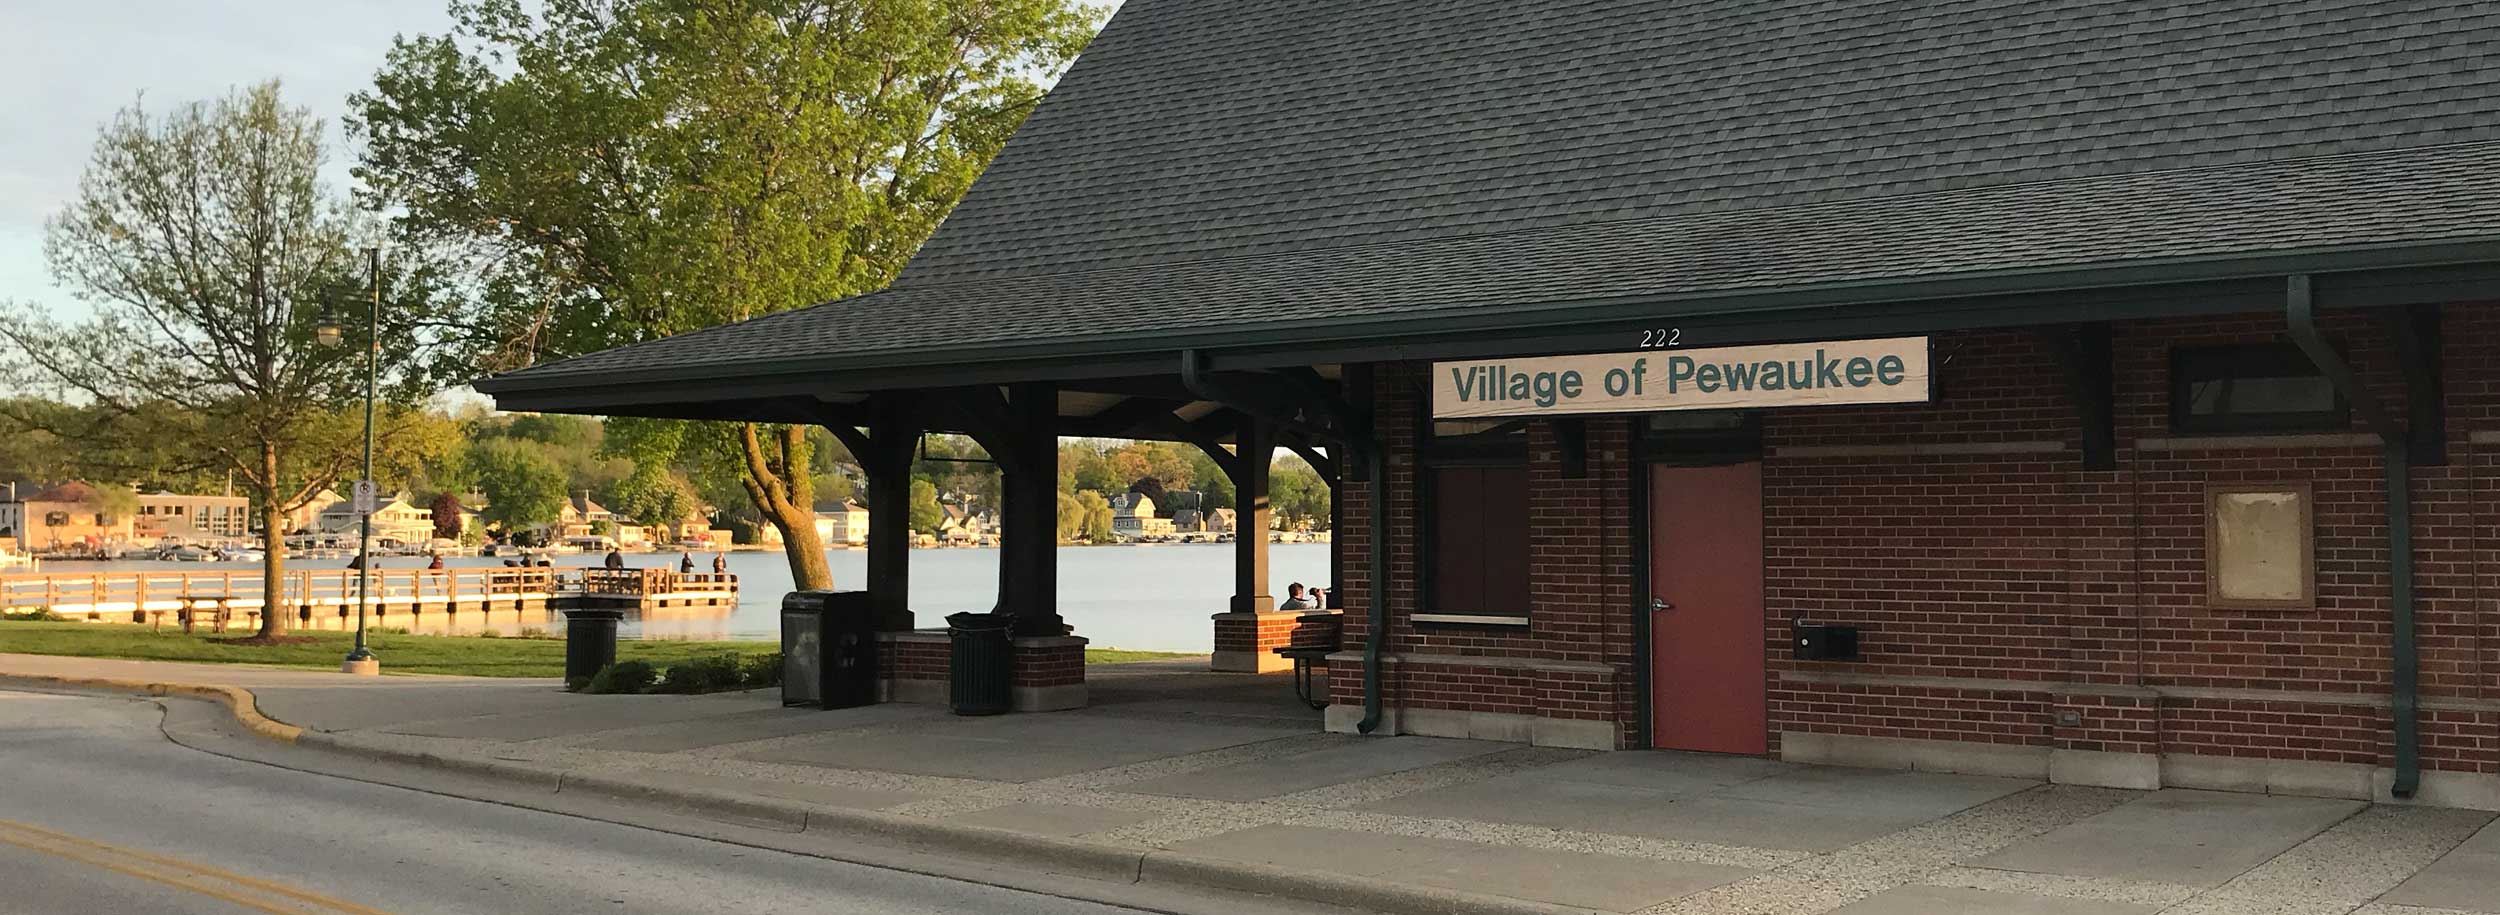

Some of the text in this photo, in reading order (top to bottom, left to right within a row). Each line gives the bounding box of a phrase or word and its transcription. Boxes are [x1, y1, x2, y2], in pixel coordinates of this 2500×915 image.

[1640, 328, 1681, 347] 222
[1451, 349, 1905, 407] Village of Pewaukee
